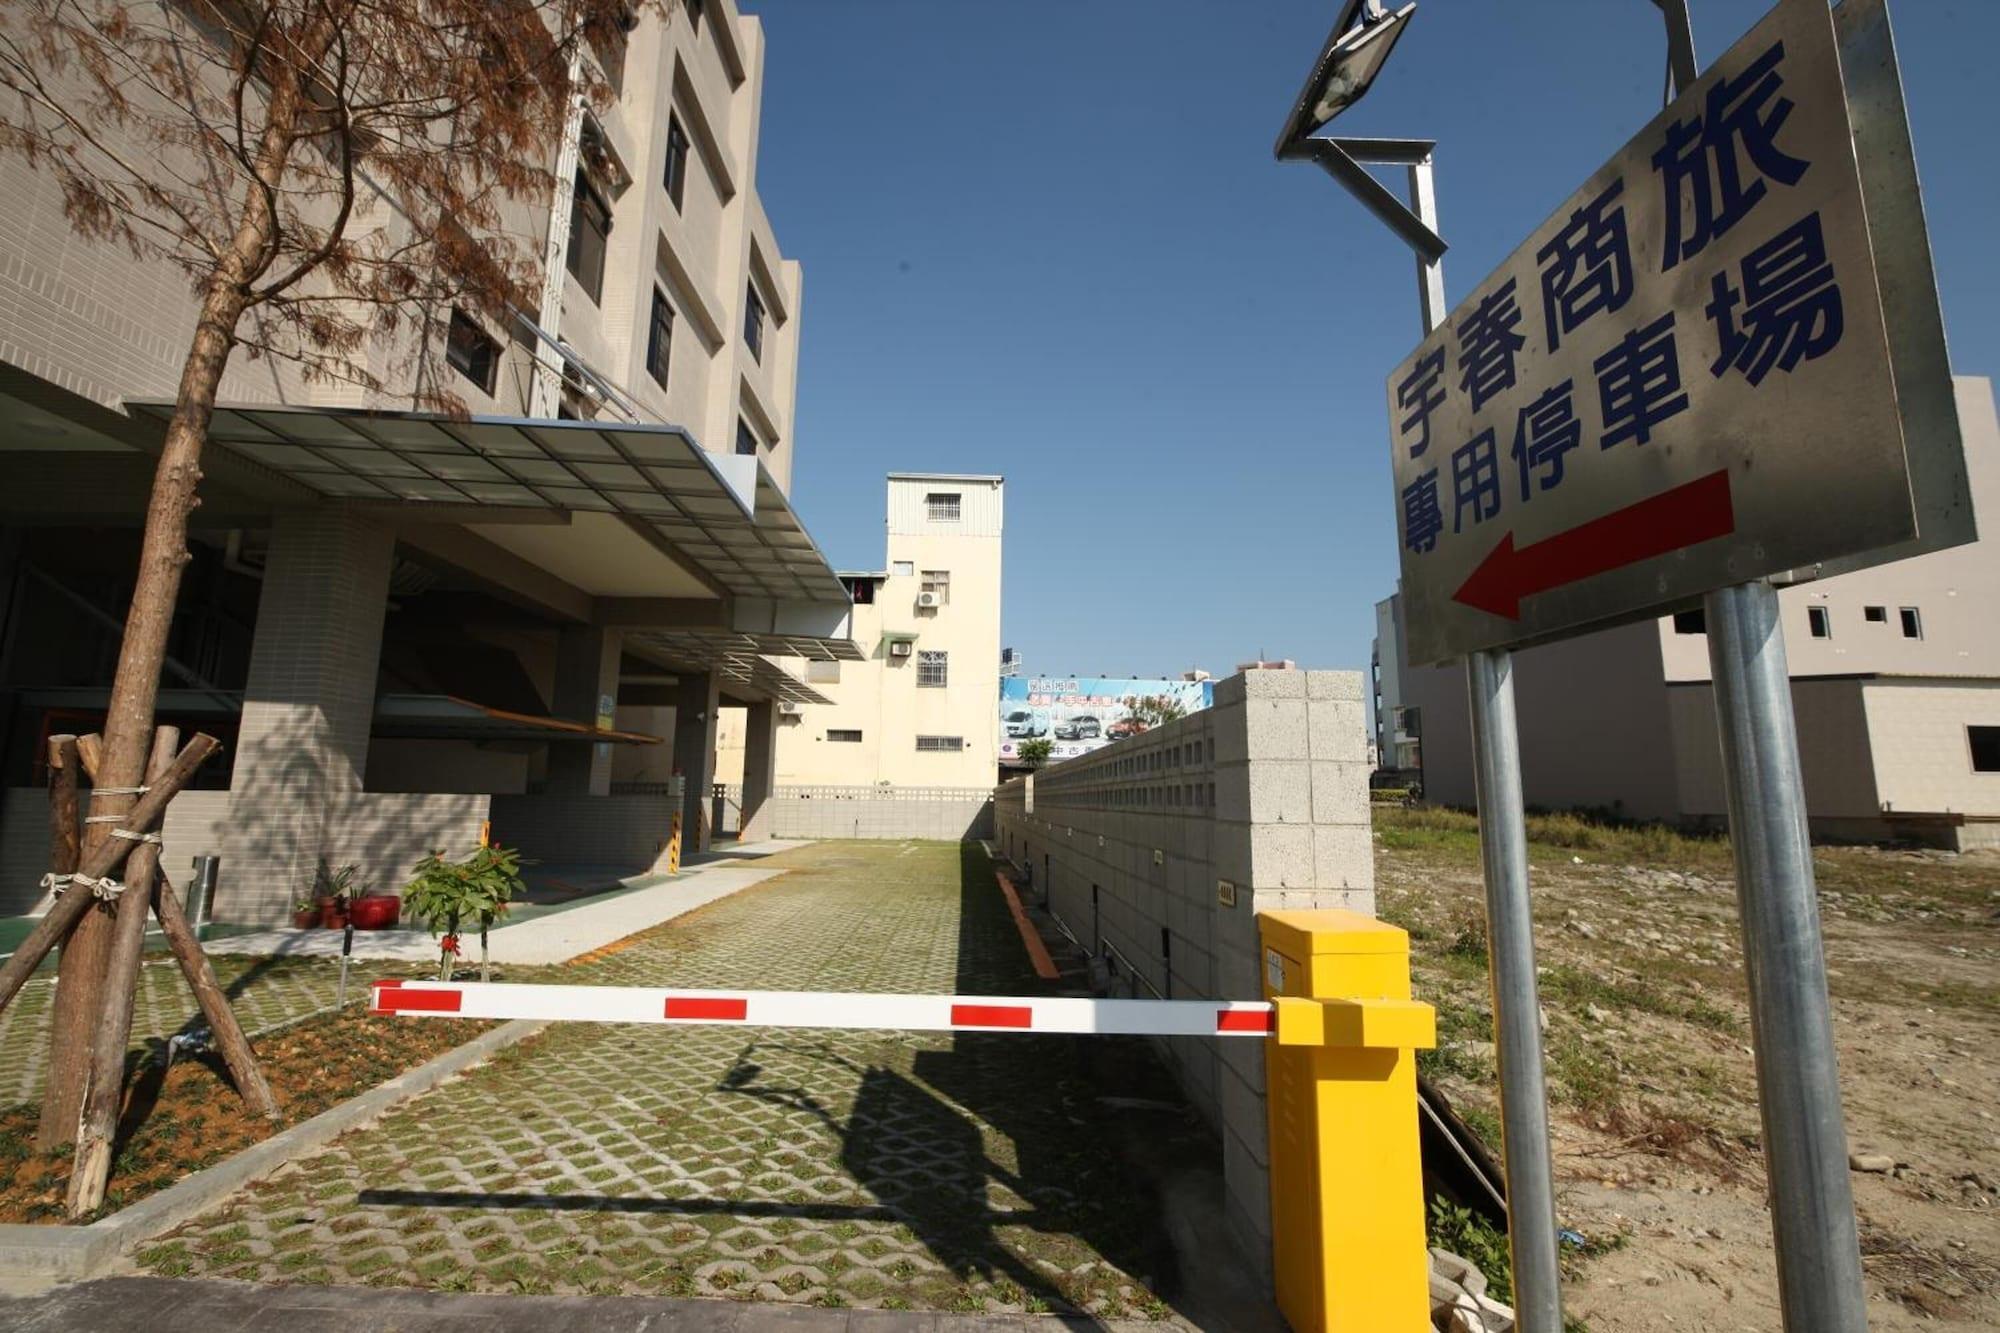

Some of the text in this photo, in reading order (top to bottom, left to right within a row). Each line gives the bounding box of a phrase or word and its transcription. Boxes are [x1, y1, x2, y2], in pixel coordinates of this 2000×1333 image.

[1398, 39, 1811, 459] 宇春商旅
[1402, 210, 1844, 555] 專用停車場
